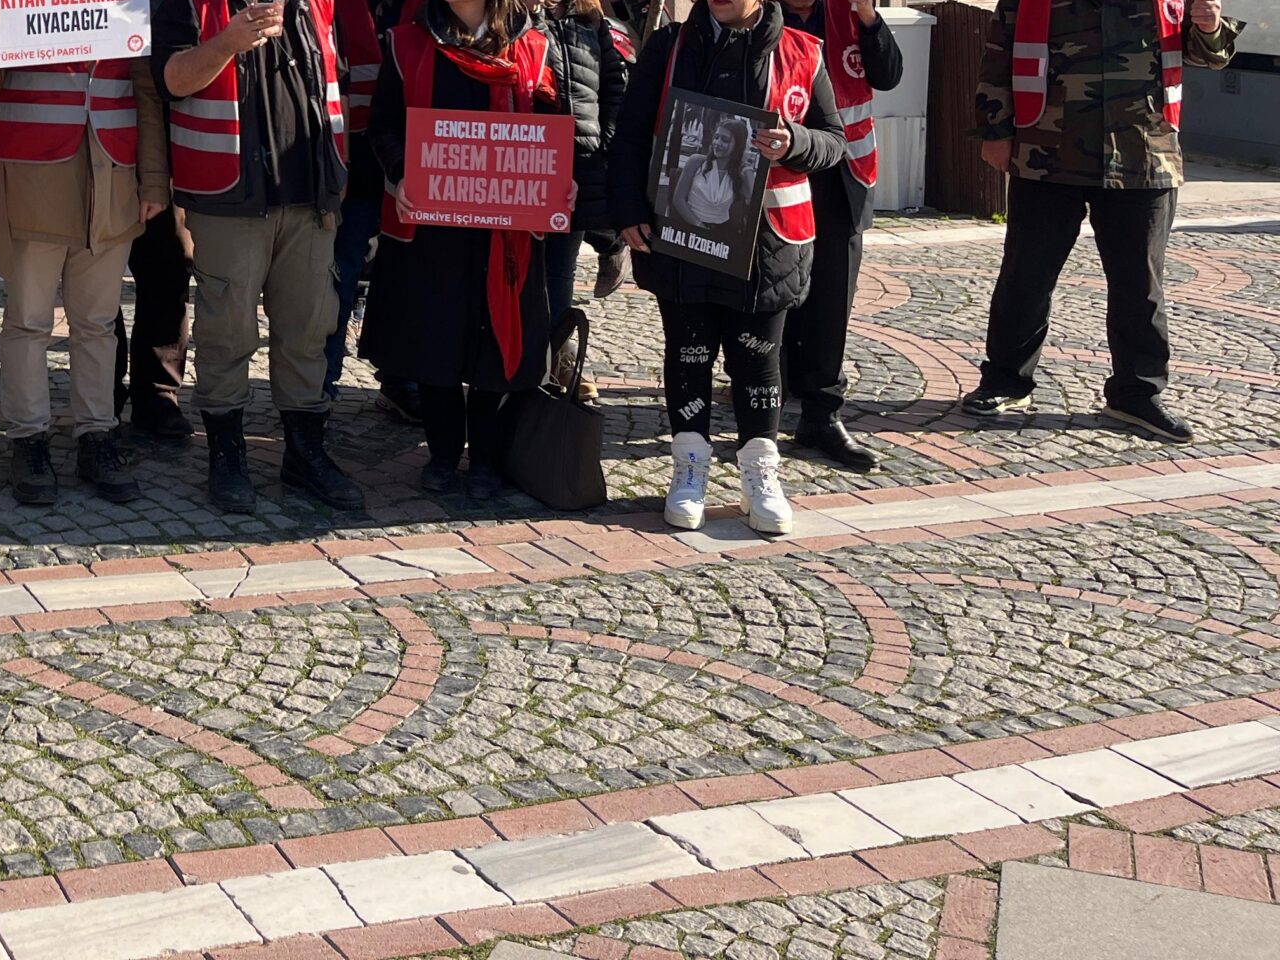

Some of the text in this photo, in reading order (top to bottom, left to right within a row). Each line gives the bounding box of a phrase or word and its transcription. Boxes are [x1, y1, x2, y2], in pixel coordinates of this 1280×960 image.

[26, 8, 108, 36] KIYACAĞIZ!
[37, 46, 56, 60] İŞÇİ
[57, 44, 92, 57] PARTİSİ
[435, 120, 546, 143] GENÇLER ÇIKACAK
[421, 142, 558, 176] MESEM TARİHE
[428, 174, 547, 207] KARIŞACAK!
[410, 210, 512, 226] TÜRKİYE İŞÇİ PARTİSİ
[660, 225, 730, 260] HİLAL ÖZDEMİR
[680, 344, 710, 355] COOL
[680, 354, 709, 364] SQUAD
[677, 397, 706, 421] ICON
[750, 396, 781, 409] GIRL
